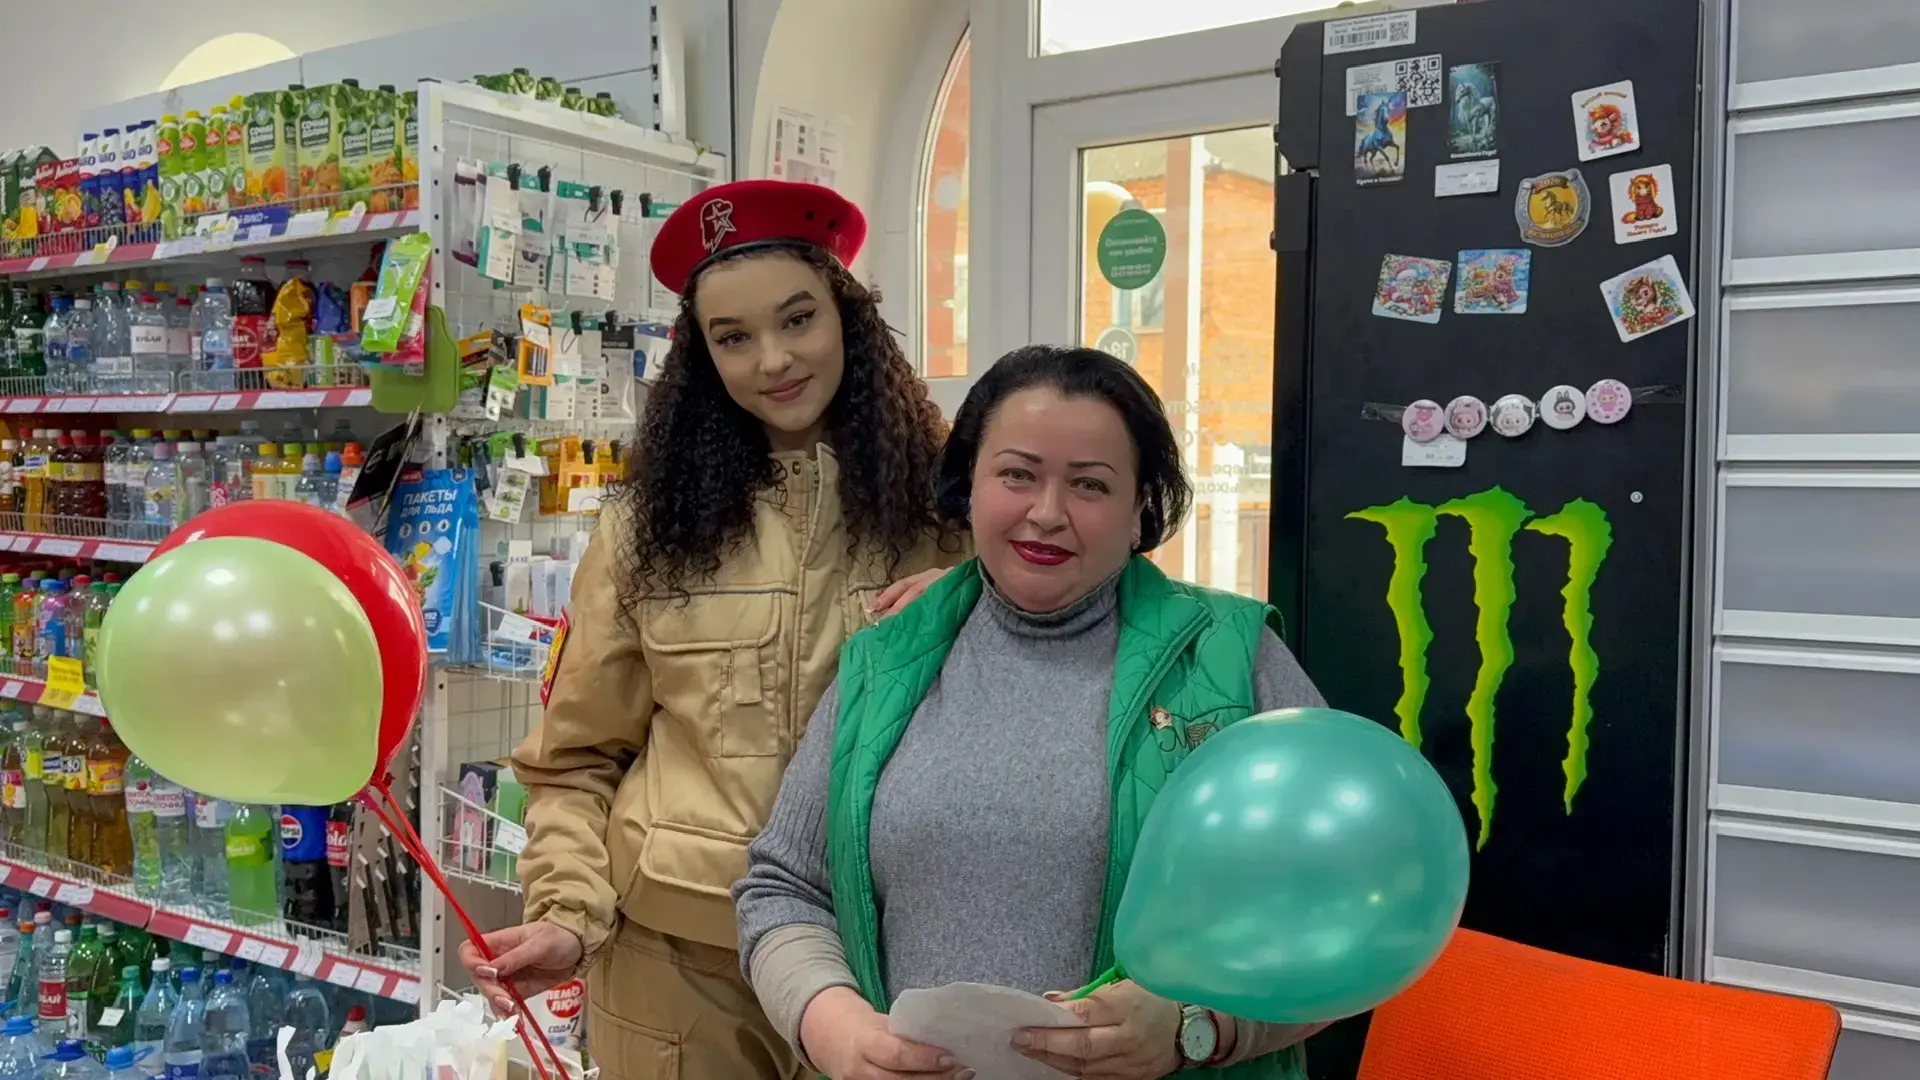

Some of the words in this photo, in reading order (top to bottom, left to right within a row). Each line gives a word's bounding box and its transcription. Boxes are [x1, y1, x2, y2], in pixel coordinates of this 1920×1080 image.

[403, 488, 458, 505] ПАКЕТЫ
[400, 505, 421, 518] ДЛЯ
[424, 503, 453, 515] ЛЬДА
[547, 1024, 571, 1034] СОДА
